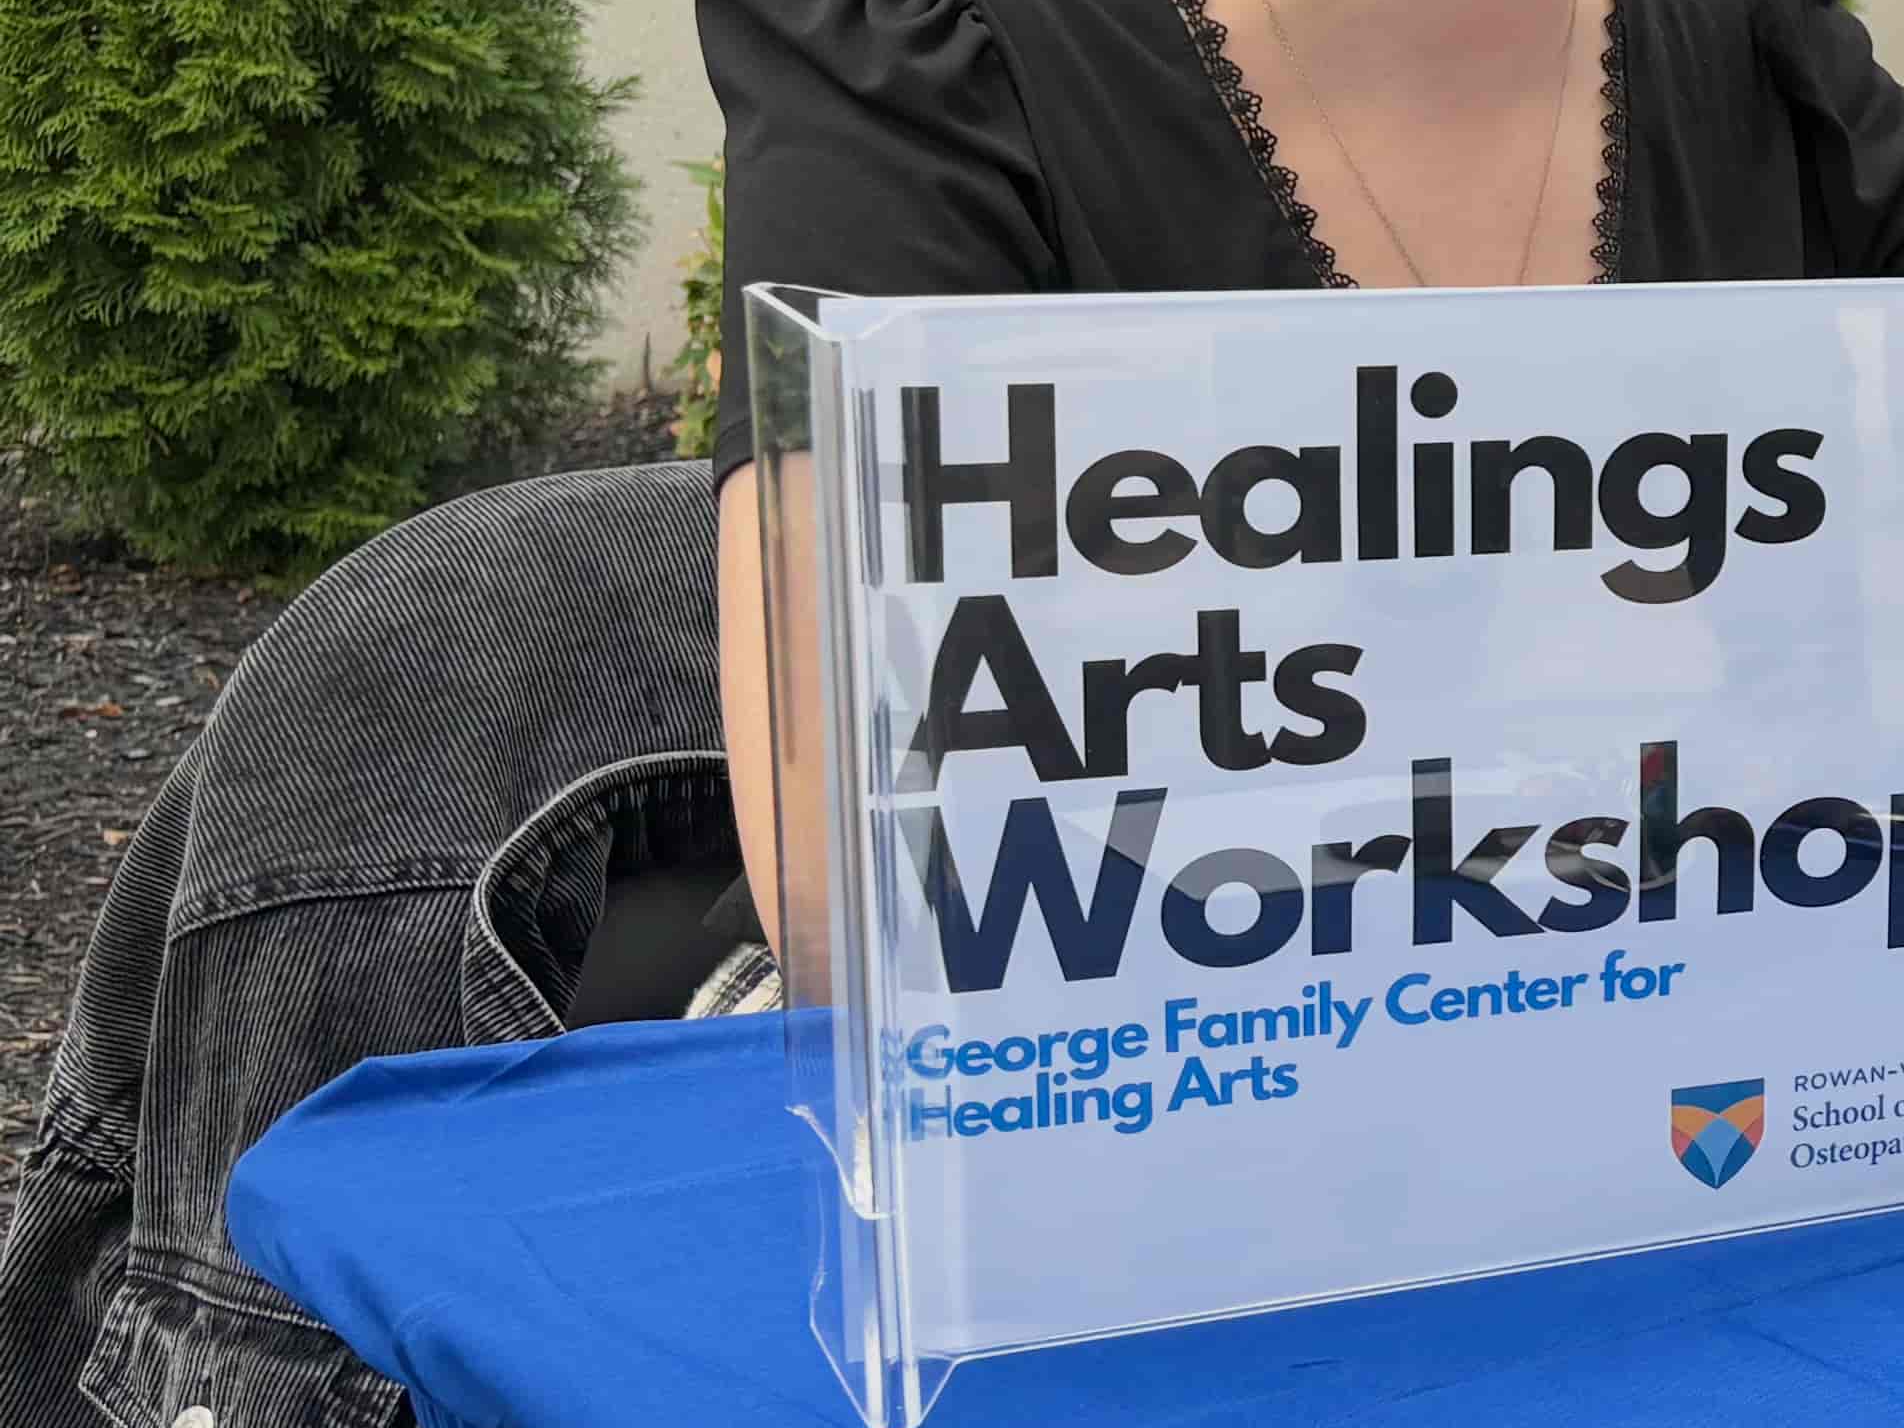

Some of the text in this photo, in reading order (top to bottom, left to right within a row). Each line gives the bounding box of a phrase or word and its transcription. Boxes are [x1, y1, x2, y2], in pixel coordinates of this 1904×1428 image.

[900, 365, 1827, 605] Healings
[897, 594, 1367, 791] Arts
[904, 952, 1685, 1080] George Family Center for
[908, 1055, 1300, 1143] Healing Arts
[1792, 1093, 1885, 1132] School
